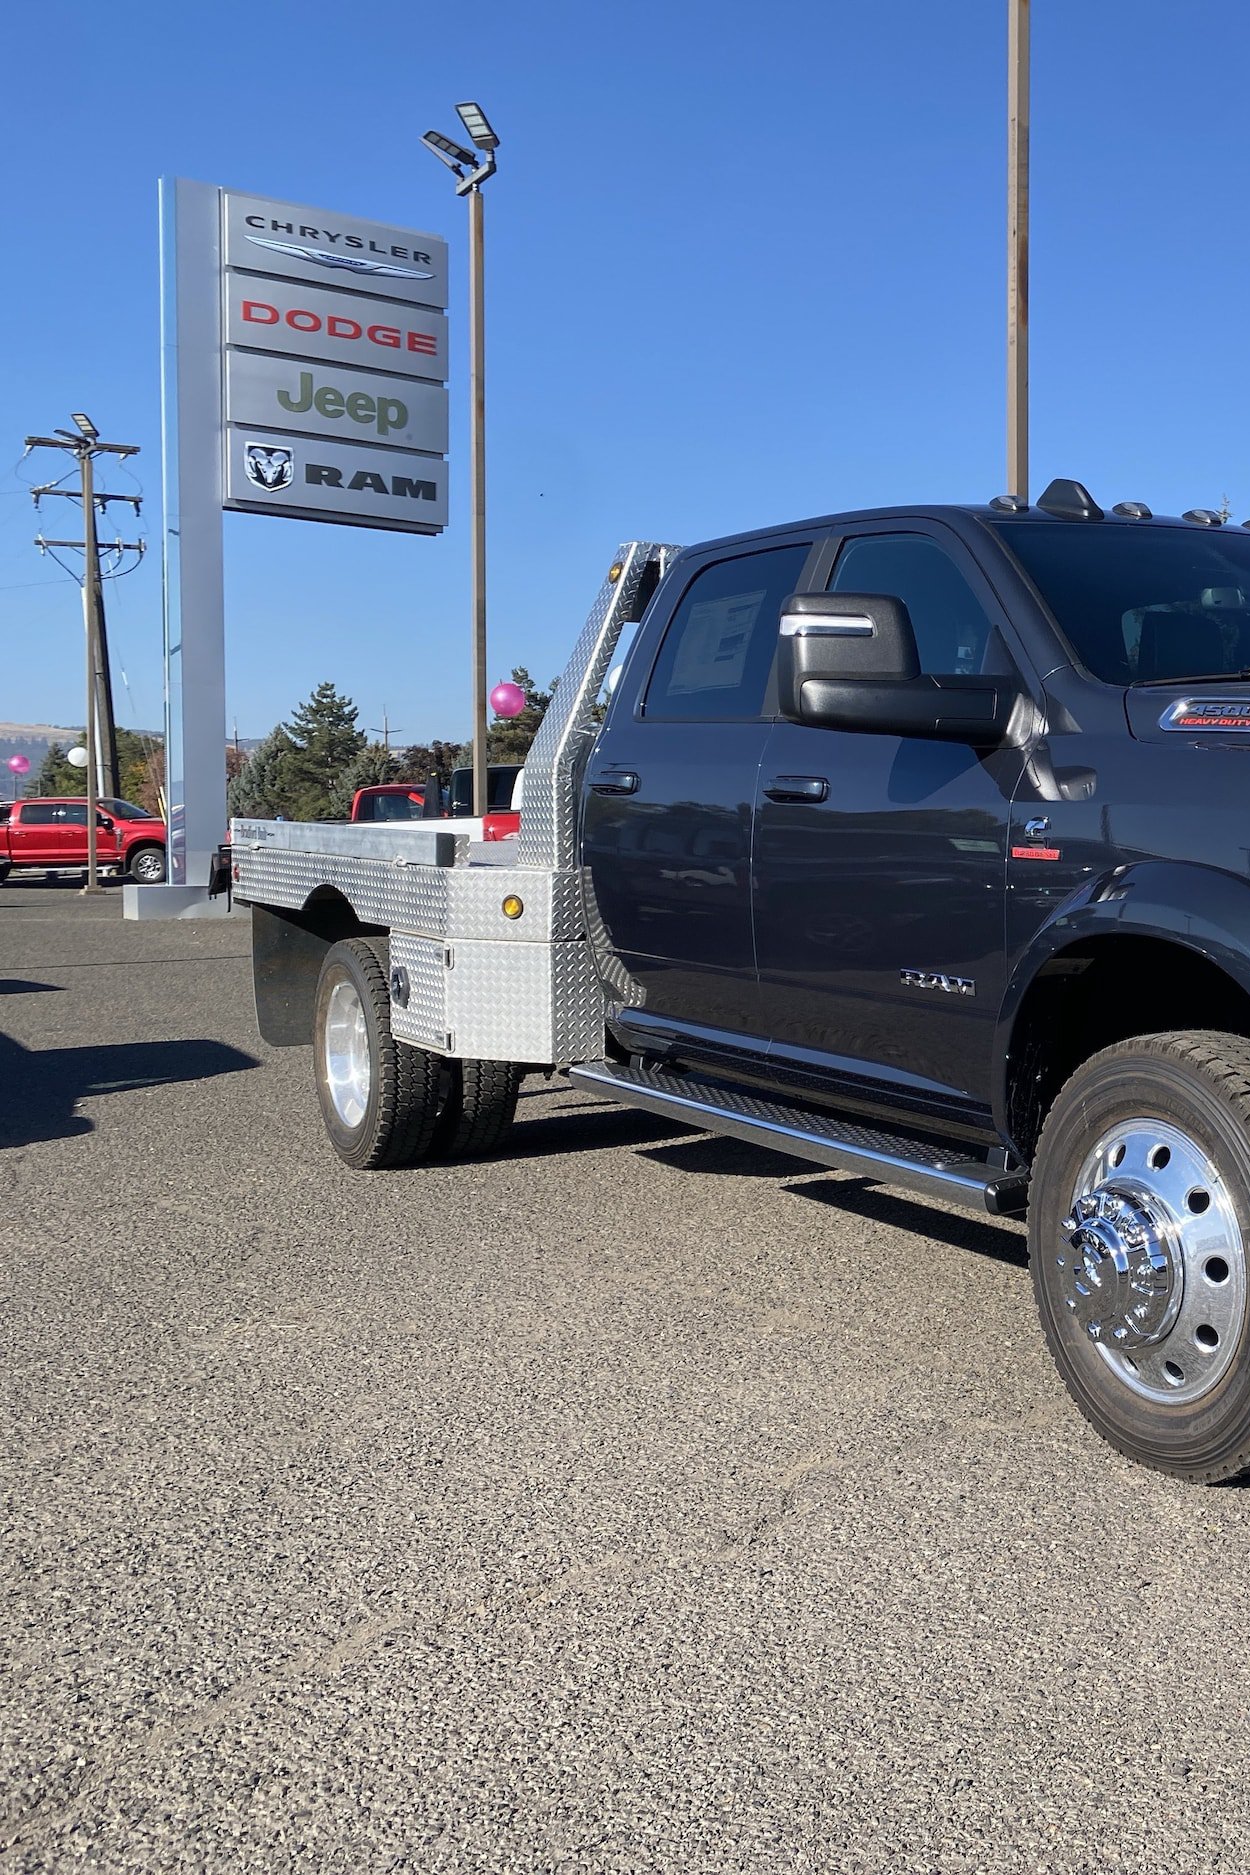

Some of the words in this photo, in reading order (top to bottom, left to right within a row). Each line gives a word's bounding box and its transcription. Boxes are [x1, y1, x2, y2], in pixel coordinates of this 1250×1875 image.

[245, 215, 432, 265] CHRYSLER
[242, 300, 437, 356] DODGE
[277, 372, 408, 435] Jeep
[305, 463, 437, 501] RAM
[1179, 718, 1219, 726] HEAVY
